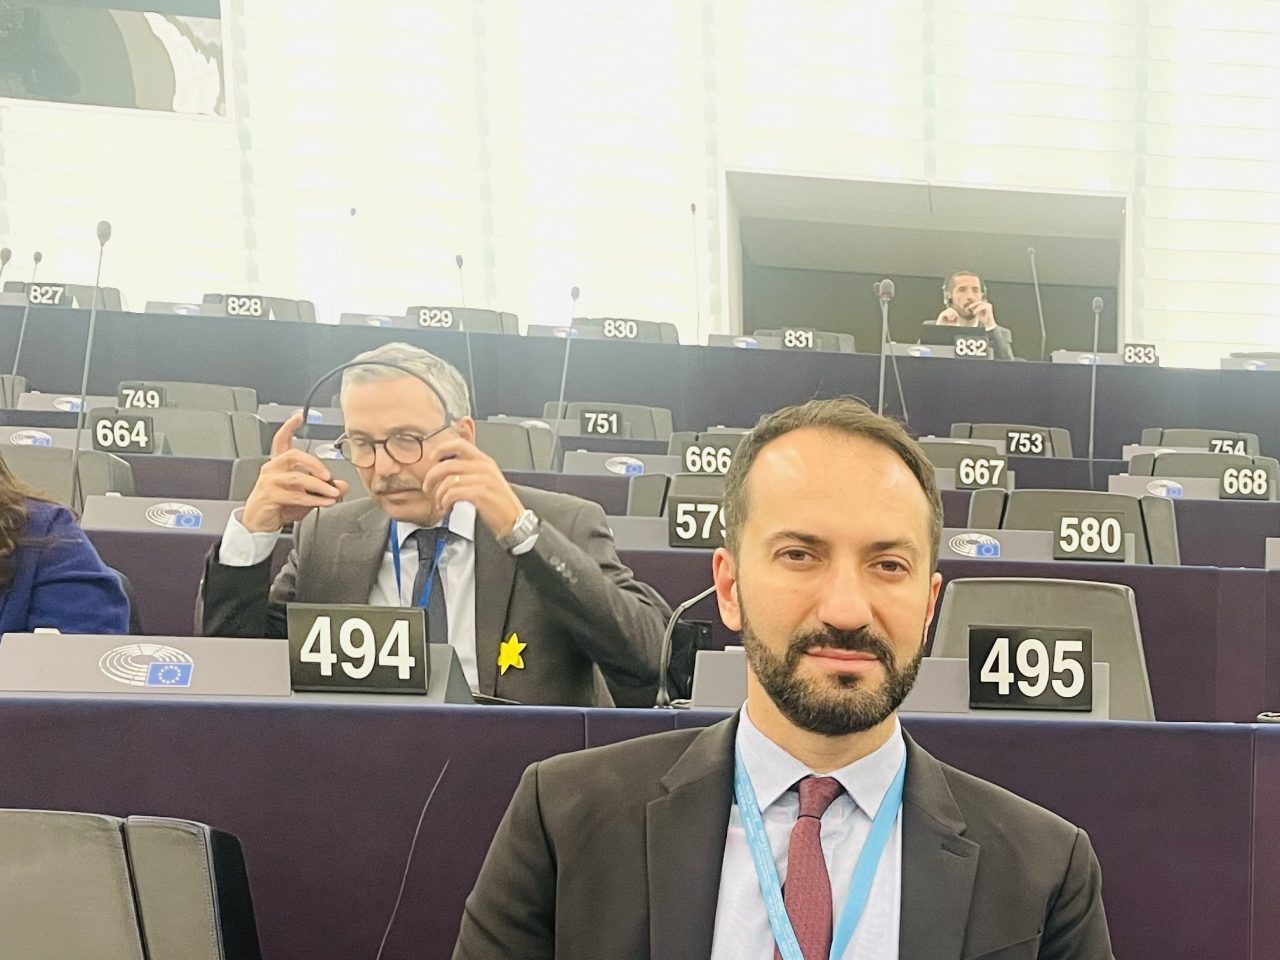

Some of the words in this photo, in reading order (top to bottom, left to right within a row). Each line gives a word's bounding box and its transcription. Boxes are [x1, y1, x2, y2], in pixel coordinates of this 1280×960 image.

[30, 286, 63, 304] 827
[227, 297, 262, 316] 828
[419, 309, 453, 328] 829
[604, 320, 637, 338] 830
[785, 330, 815, 348] 831
[955, 338, 987, 357] 832
[1124, 346, 1156, 364] 833
[122, 390, 160, 408] 749
[585, 413, 618, 434] 751
[96, 420, 148, 448] 664
[1008, 433, 1043, 453] 753
[1211, 440, 1246, 455] 754
[686, 446, 732, 474] 666
[959, 459, 1004, 485] 667
[1223, 468, 1268, 495] 668
[1060, 518, 1121, 554] 580
[301, 617, 415, 680] 494
[981, 638, 1084, 698] 495
